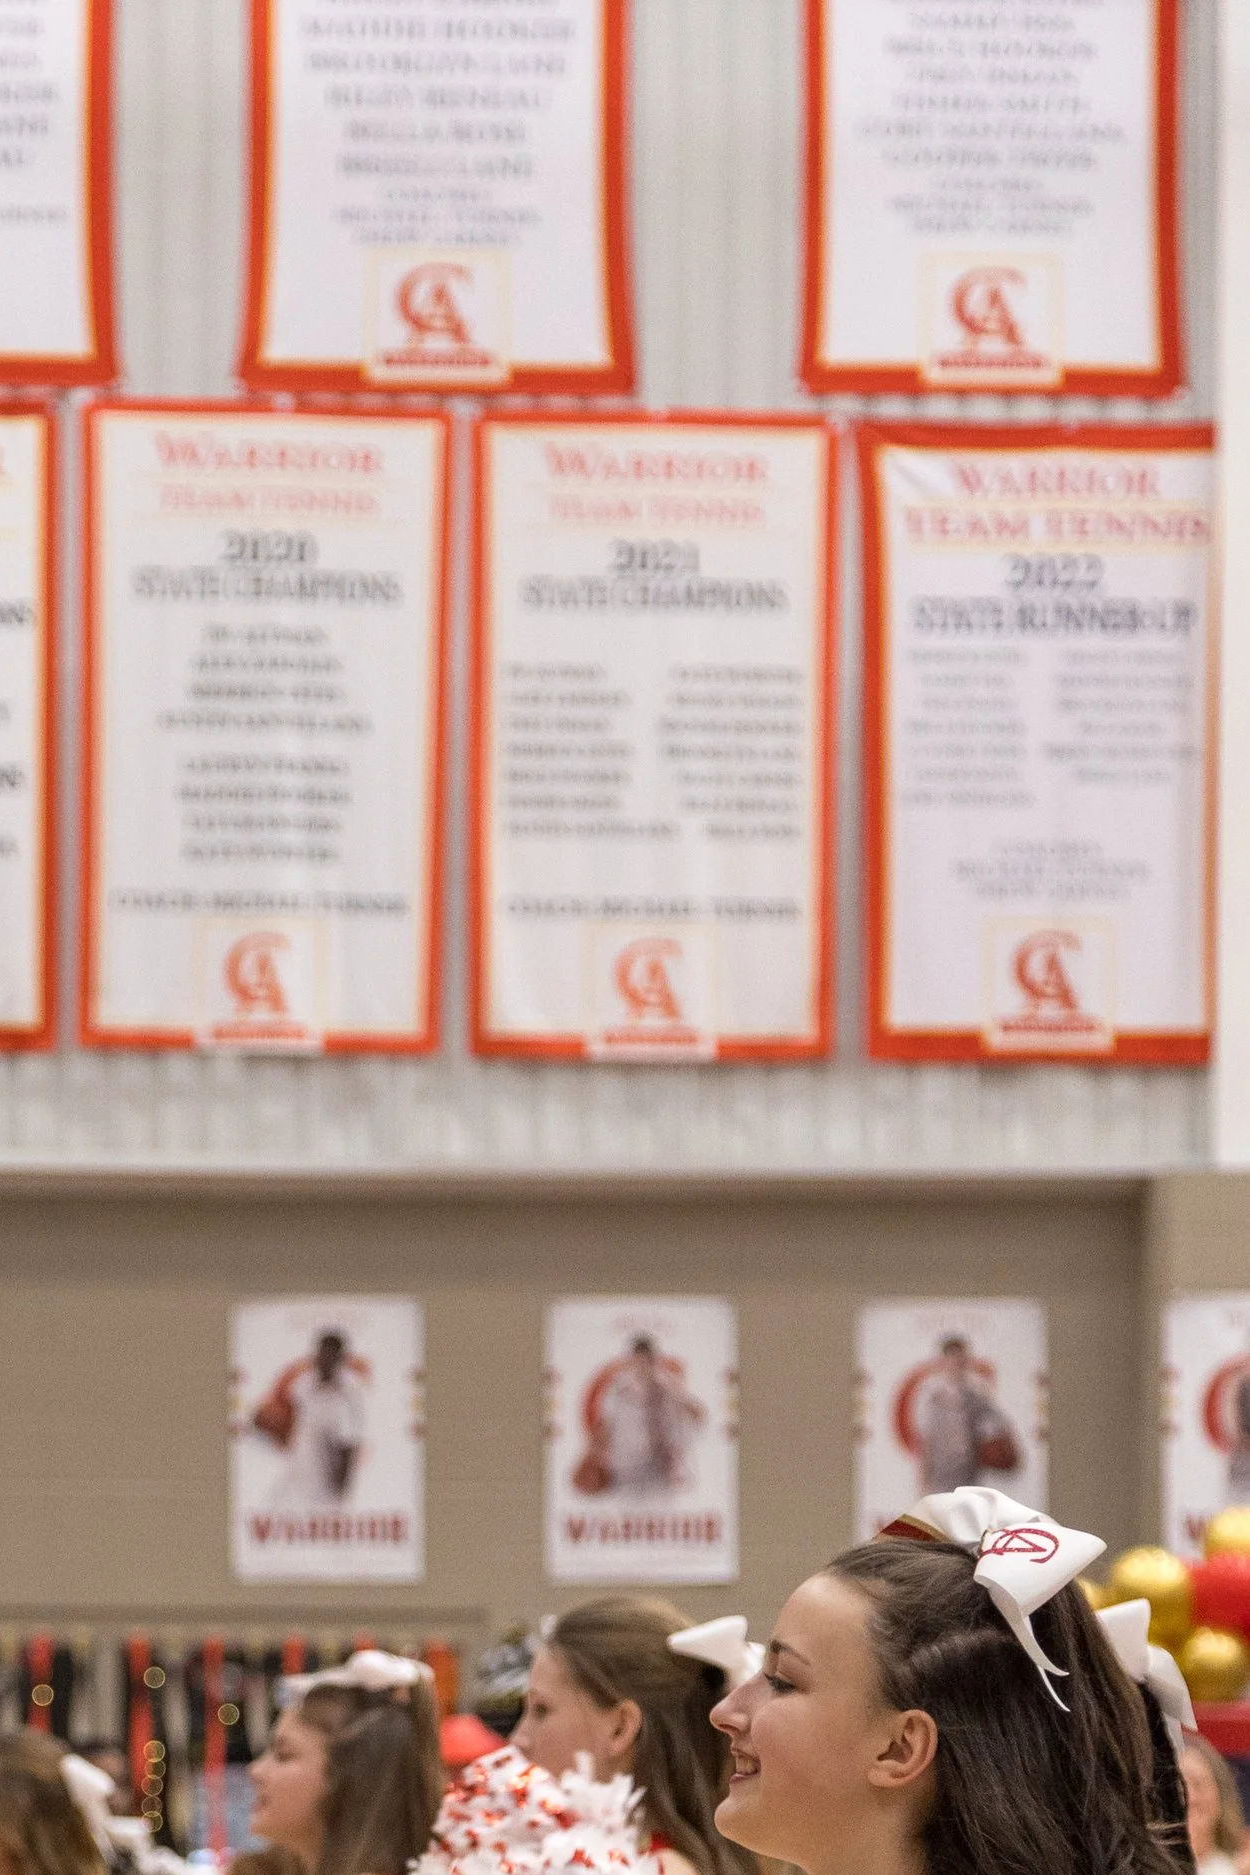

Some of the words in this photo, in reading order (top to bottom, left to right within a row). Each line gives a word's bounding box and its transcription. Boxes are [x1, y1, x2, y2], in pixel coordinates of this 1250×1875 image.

[153, 433, 383, 479] WARRIOR
[539, 443, 768, 489] WARRIOR
[948, 461, 1160, 502] WARRIOR
[903, 508, 1032, 545] TEAM
[218, 531, 316, 570] 2020
[606, 540, 701, 580] 2021
[1003, 554, 1107, 595] 2022
[910, 598, 1011, 638] STATE
[243, 1511, 409, 1548] WARRIOR
[558, 1511, 724, 1549] WARRIOR
